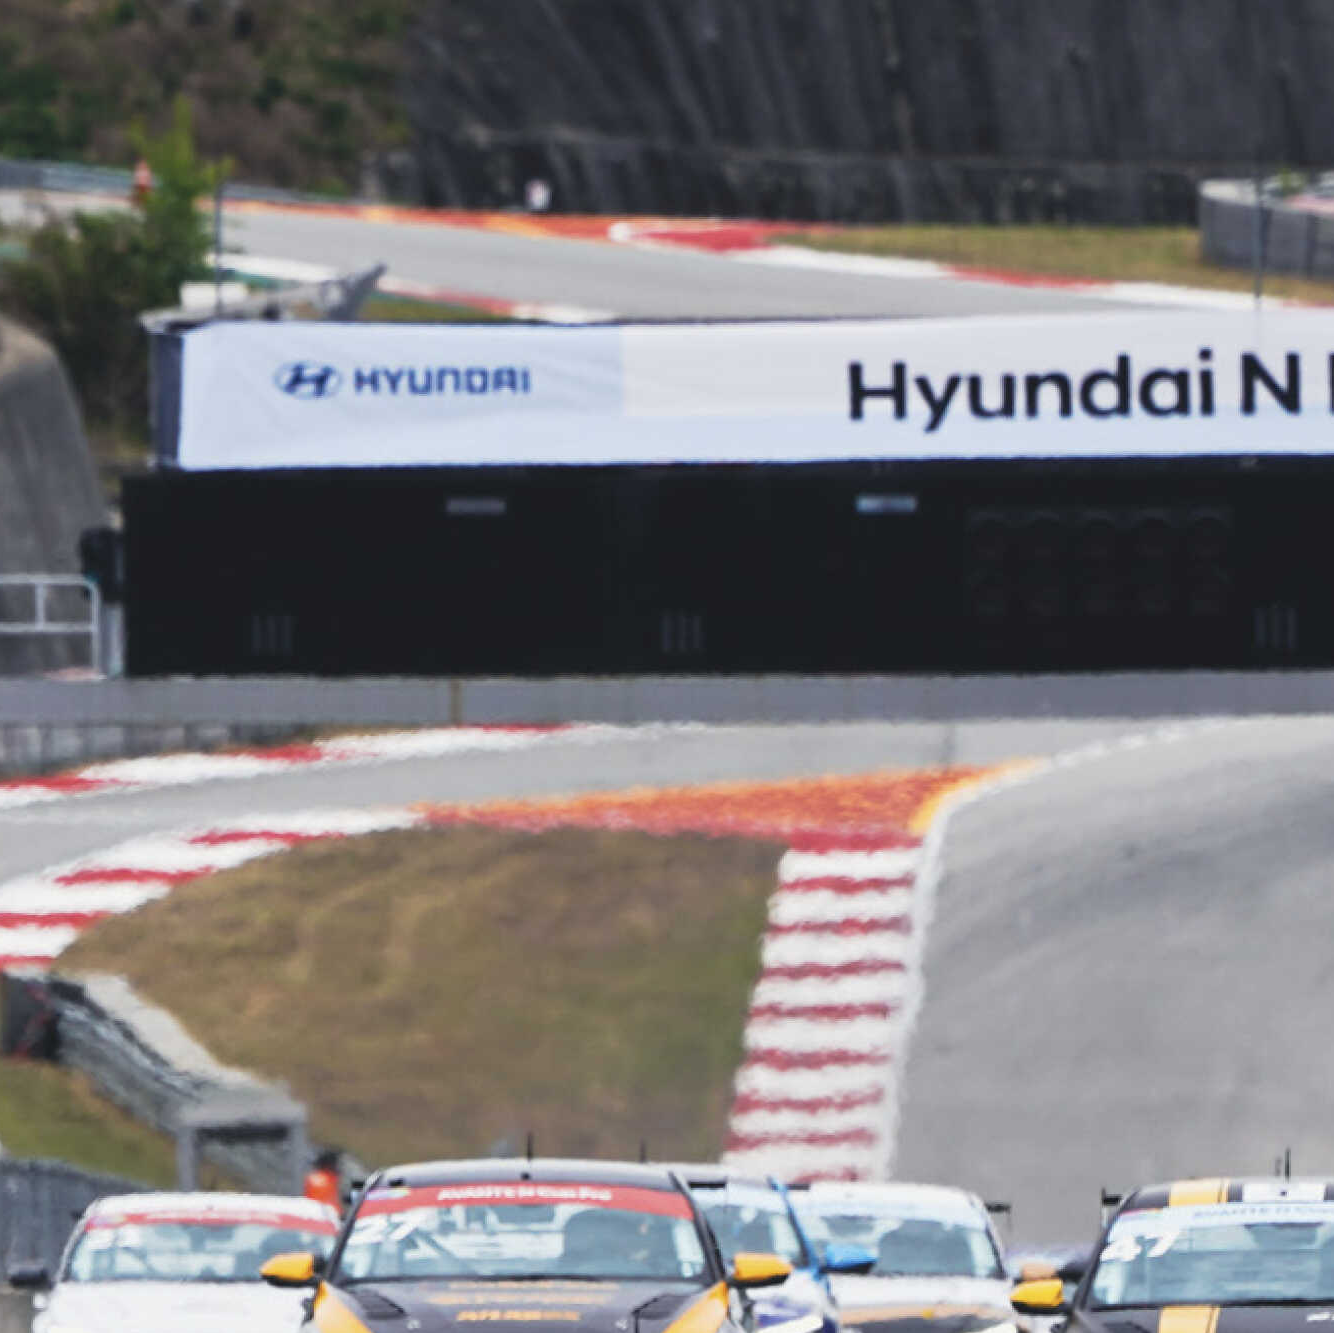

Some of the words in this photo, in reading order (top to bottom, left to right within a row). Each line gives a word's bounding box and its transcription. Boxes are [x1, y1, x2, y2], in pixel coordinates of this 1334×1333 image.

[353, 363, 532, 396] HYUNDAI
[848, 347, 1216, 434] Hyundai
[1239, 351, 1303, 417] N
